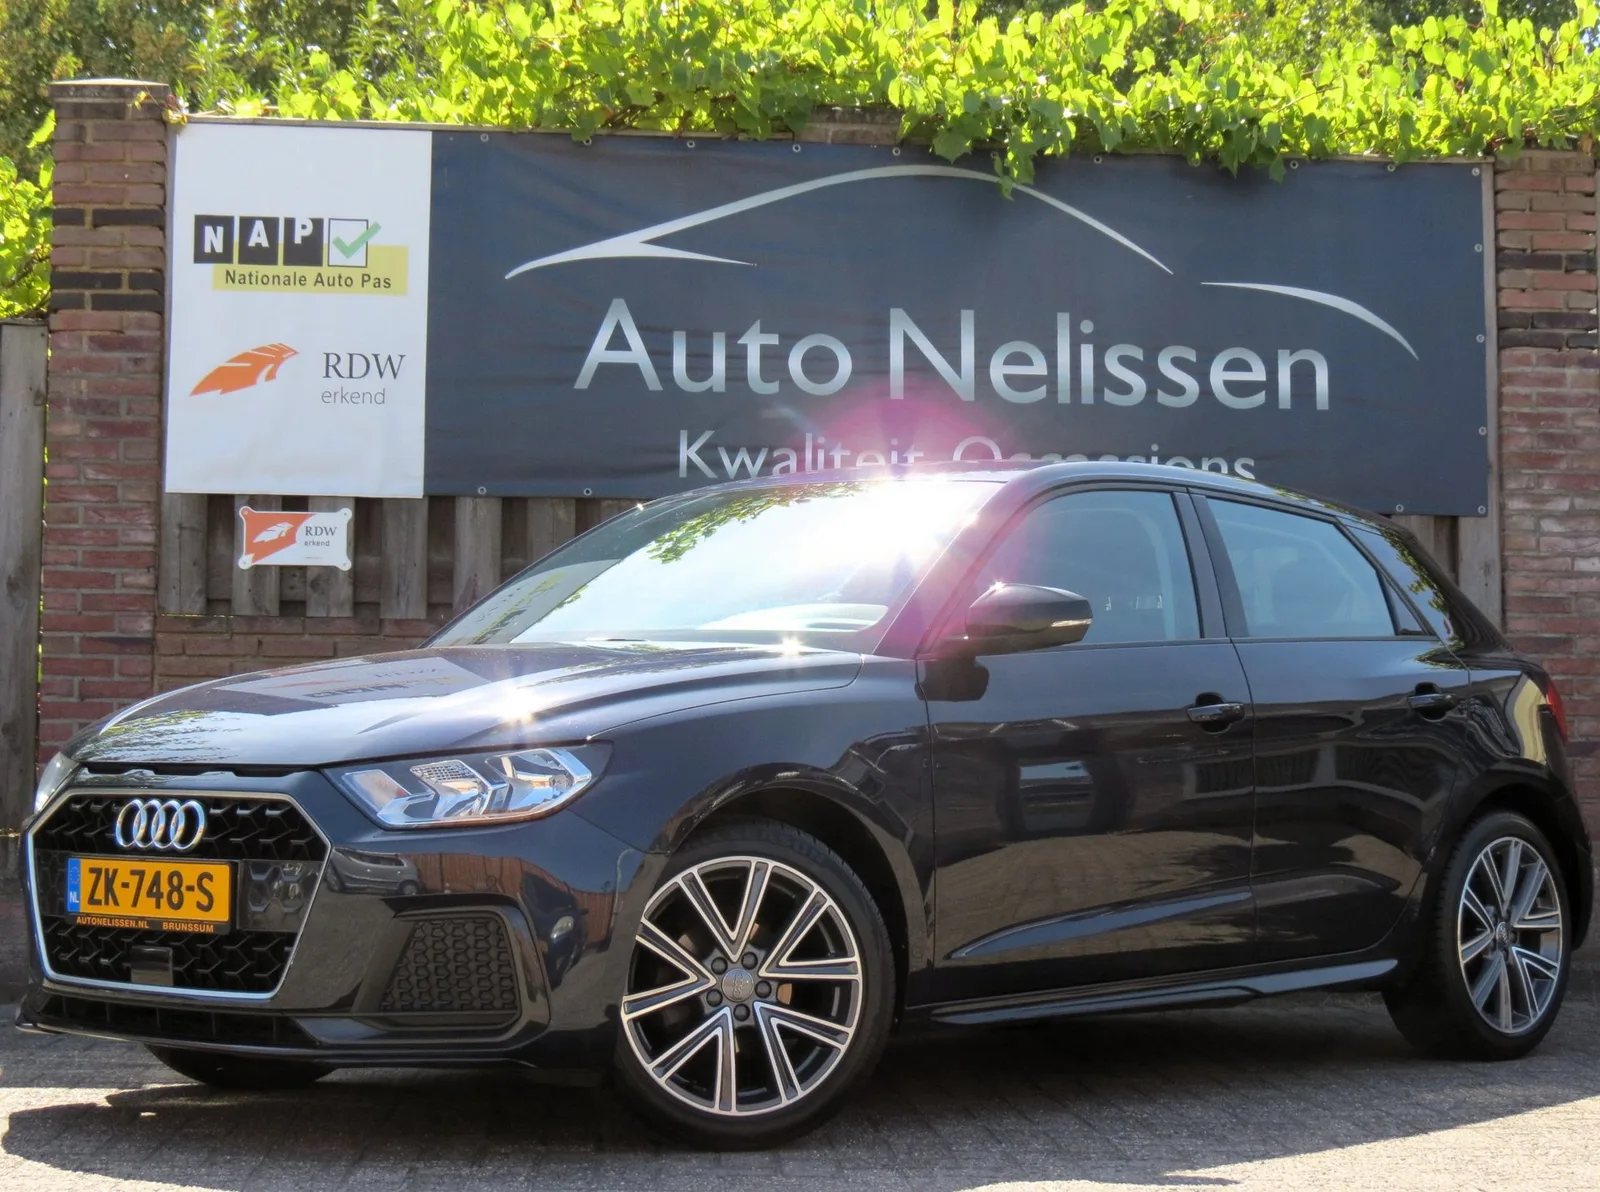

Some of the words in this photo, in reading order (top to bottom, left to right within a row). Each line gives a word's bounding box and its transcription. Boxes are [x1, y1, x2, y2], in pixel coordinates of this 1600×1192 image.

[203, 218, 314, 254] NAP
[225, 269, 307, 287] Nationale
[313, 272, 354, 288] Auto
[361, 273, 392, 289] Pas
[573, 298, 853, 396] Auto
[889, 307, 1330, 411] Nelissen
[322, 352, 406, 380] RDW
[321, 387, 386, 405] erkend
[304, 525, 337, 536] RDW
[304, 539, 330, 547] erkend
[69, 891, 79, 903] NL
[87, 867, 215, 912] ZK-748-S
[76, 916, 149, 929] AUTONELISSEN.NL
[162, 921, 214, 933] BRUNSSUM
